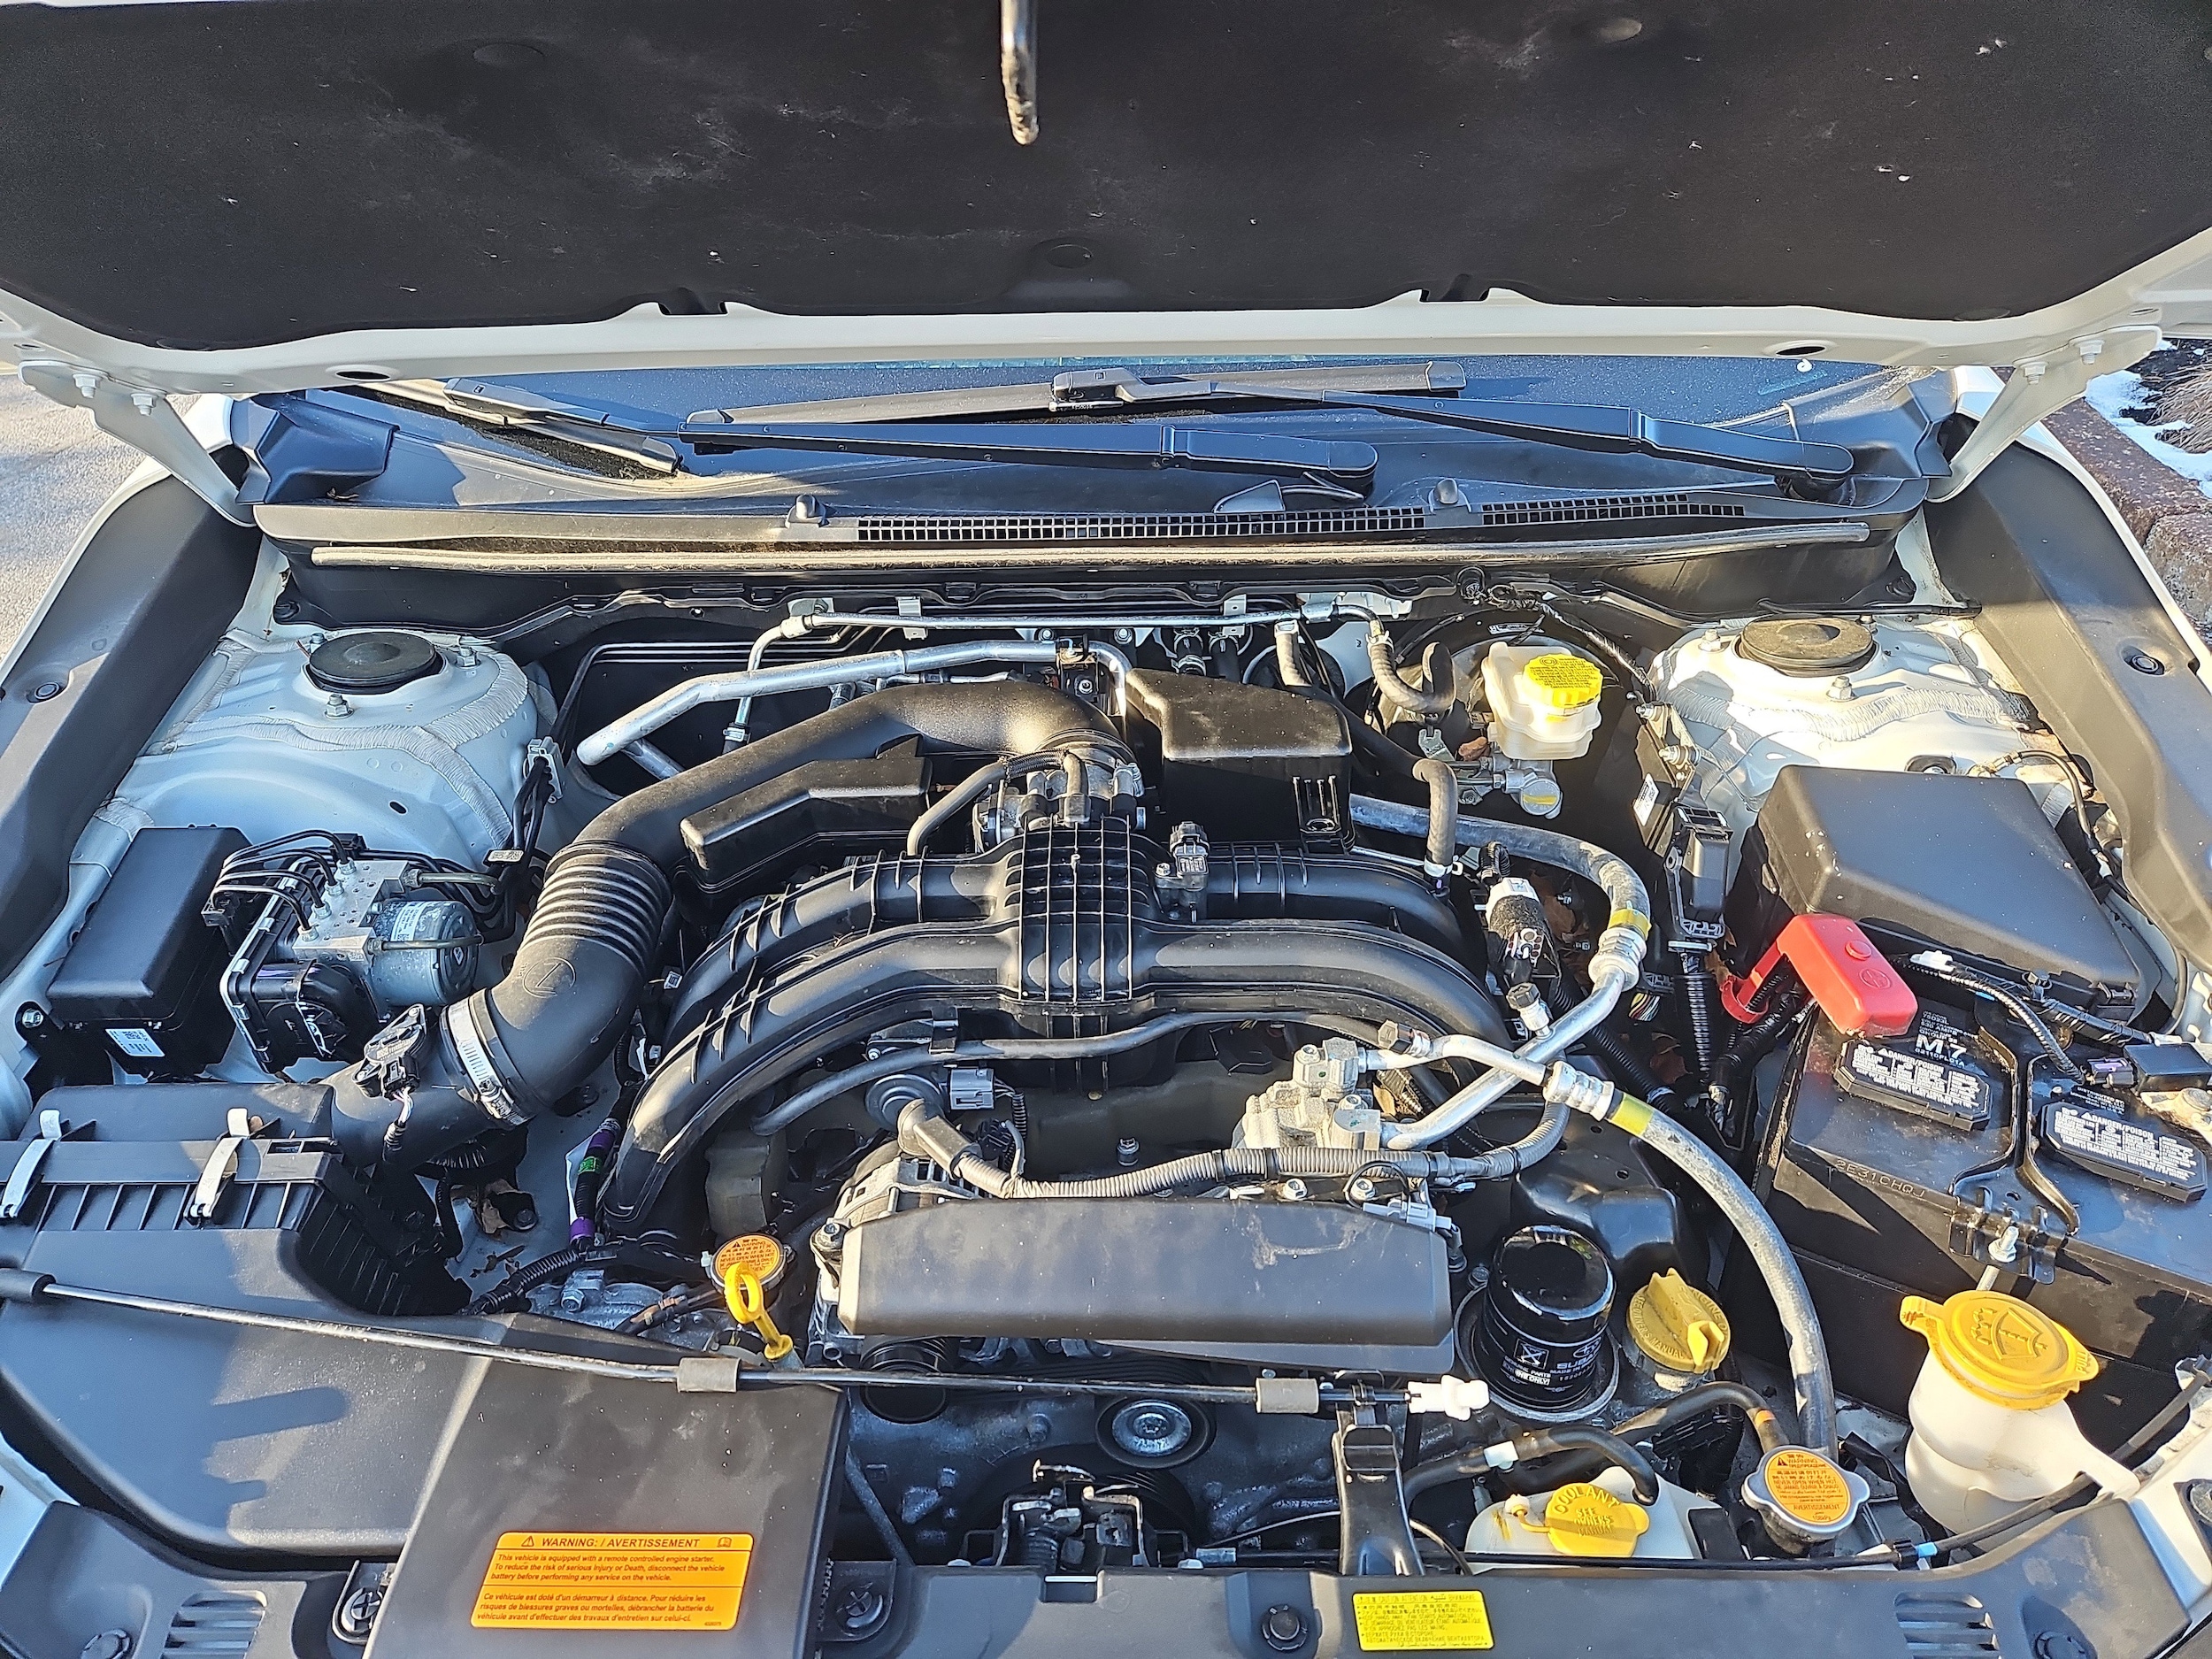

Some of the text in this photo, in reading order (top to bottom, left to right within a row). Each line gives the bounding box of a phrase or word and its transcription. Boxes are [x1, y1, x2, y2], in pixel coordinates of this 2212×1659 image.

[1888, 1052, 1945, 1074] DANGER/POISON
[2092, 1115, 2154, 1139] DANGER/POISON
[1691, 1289, 1723, 1320] NGINE
[1649, 1337, 1684, 1359] MANUAL
[2075, 1351, 2088, 1375] PULL
[1531, 1370, 1551, 1379] PARTS
[1554, 1486, 1621, 1514] COOLANT
[1576, 1507, 1596, 1518] SEE
[541, 1538, 598, 1548] WARNING:
[607, 1539, 700, 1548] AVERTISSEMENT
[549, 1555, 580, 1564] equipped
